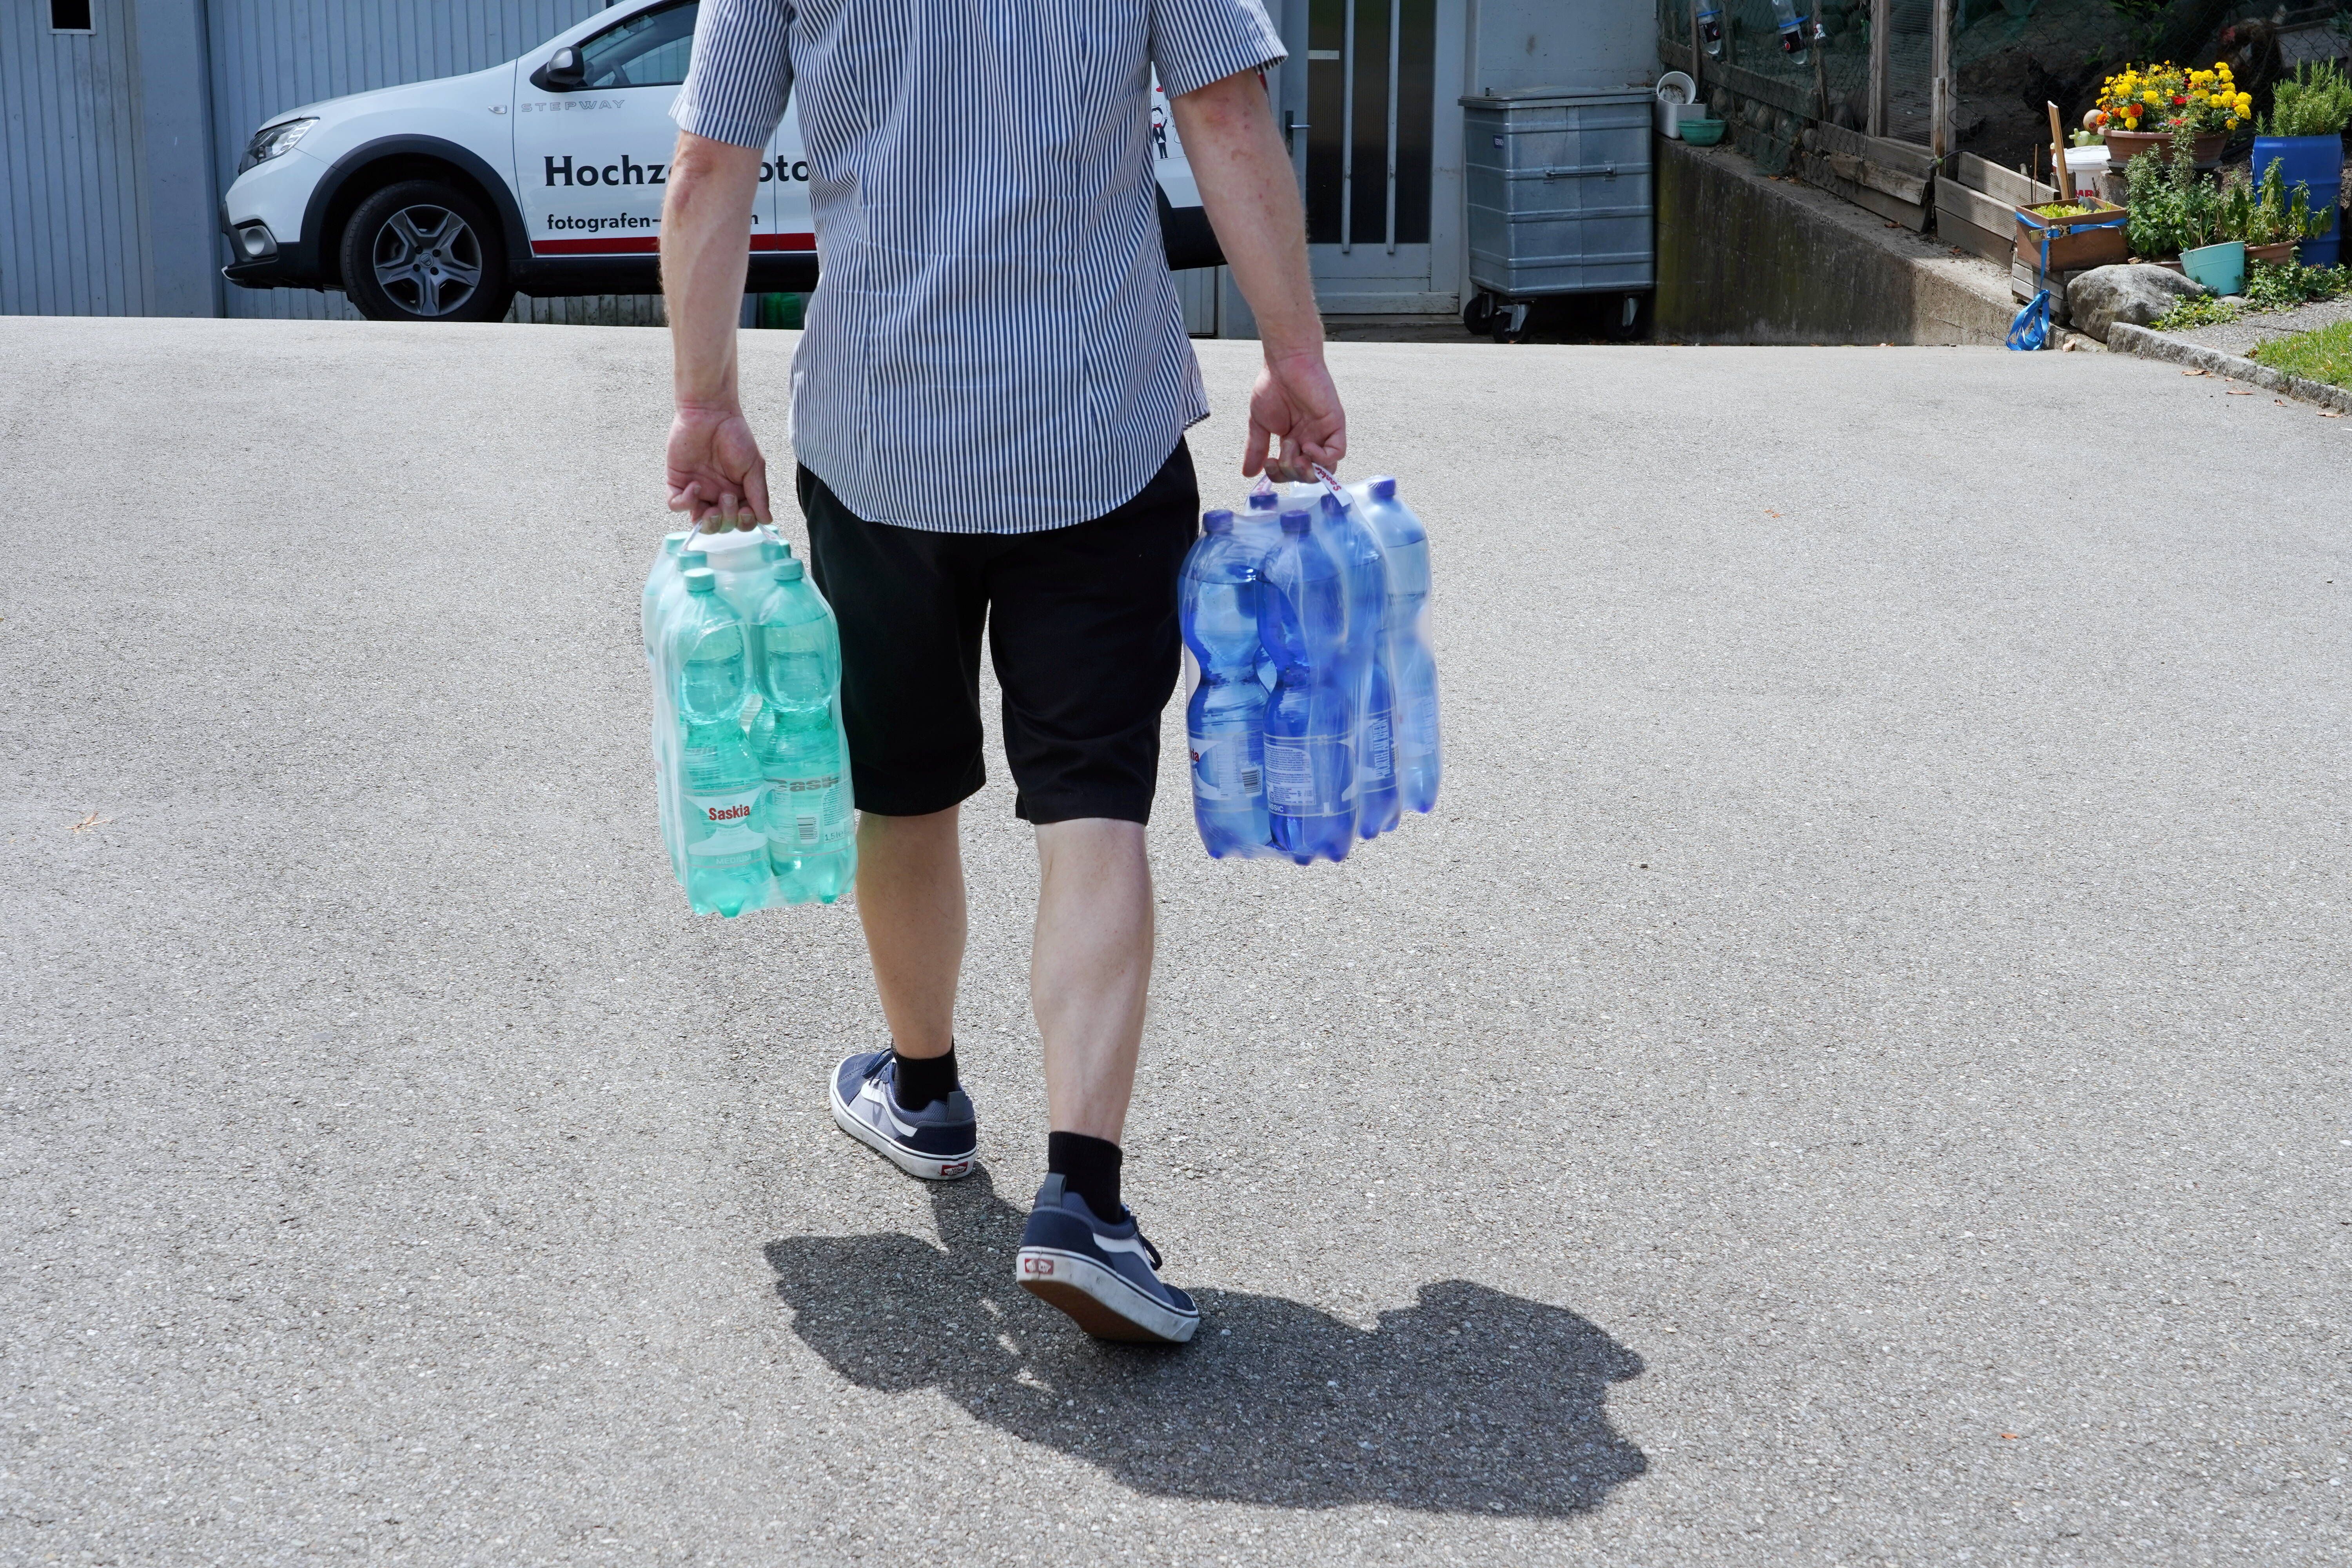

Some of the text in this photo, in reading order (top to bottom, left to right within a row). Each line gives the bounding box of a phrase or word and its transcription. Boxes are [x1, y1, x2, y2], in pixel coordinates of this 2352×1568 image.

[521, 100, 625, 113] STEPWAY
[543, 154, 673, 187] Hochz
[708, 804, 750, 821] Saskia
[716, 853, 751, 864] MEDIUM
